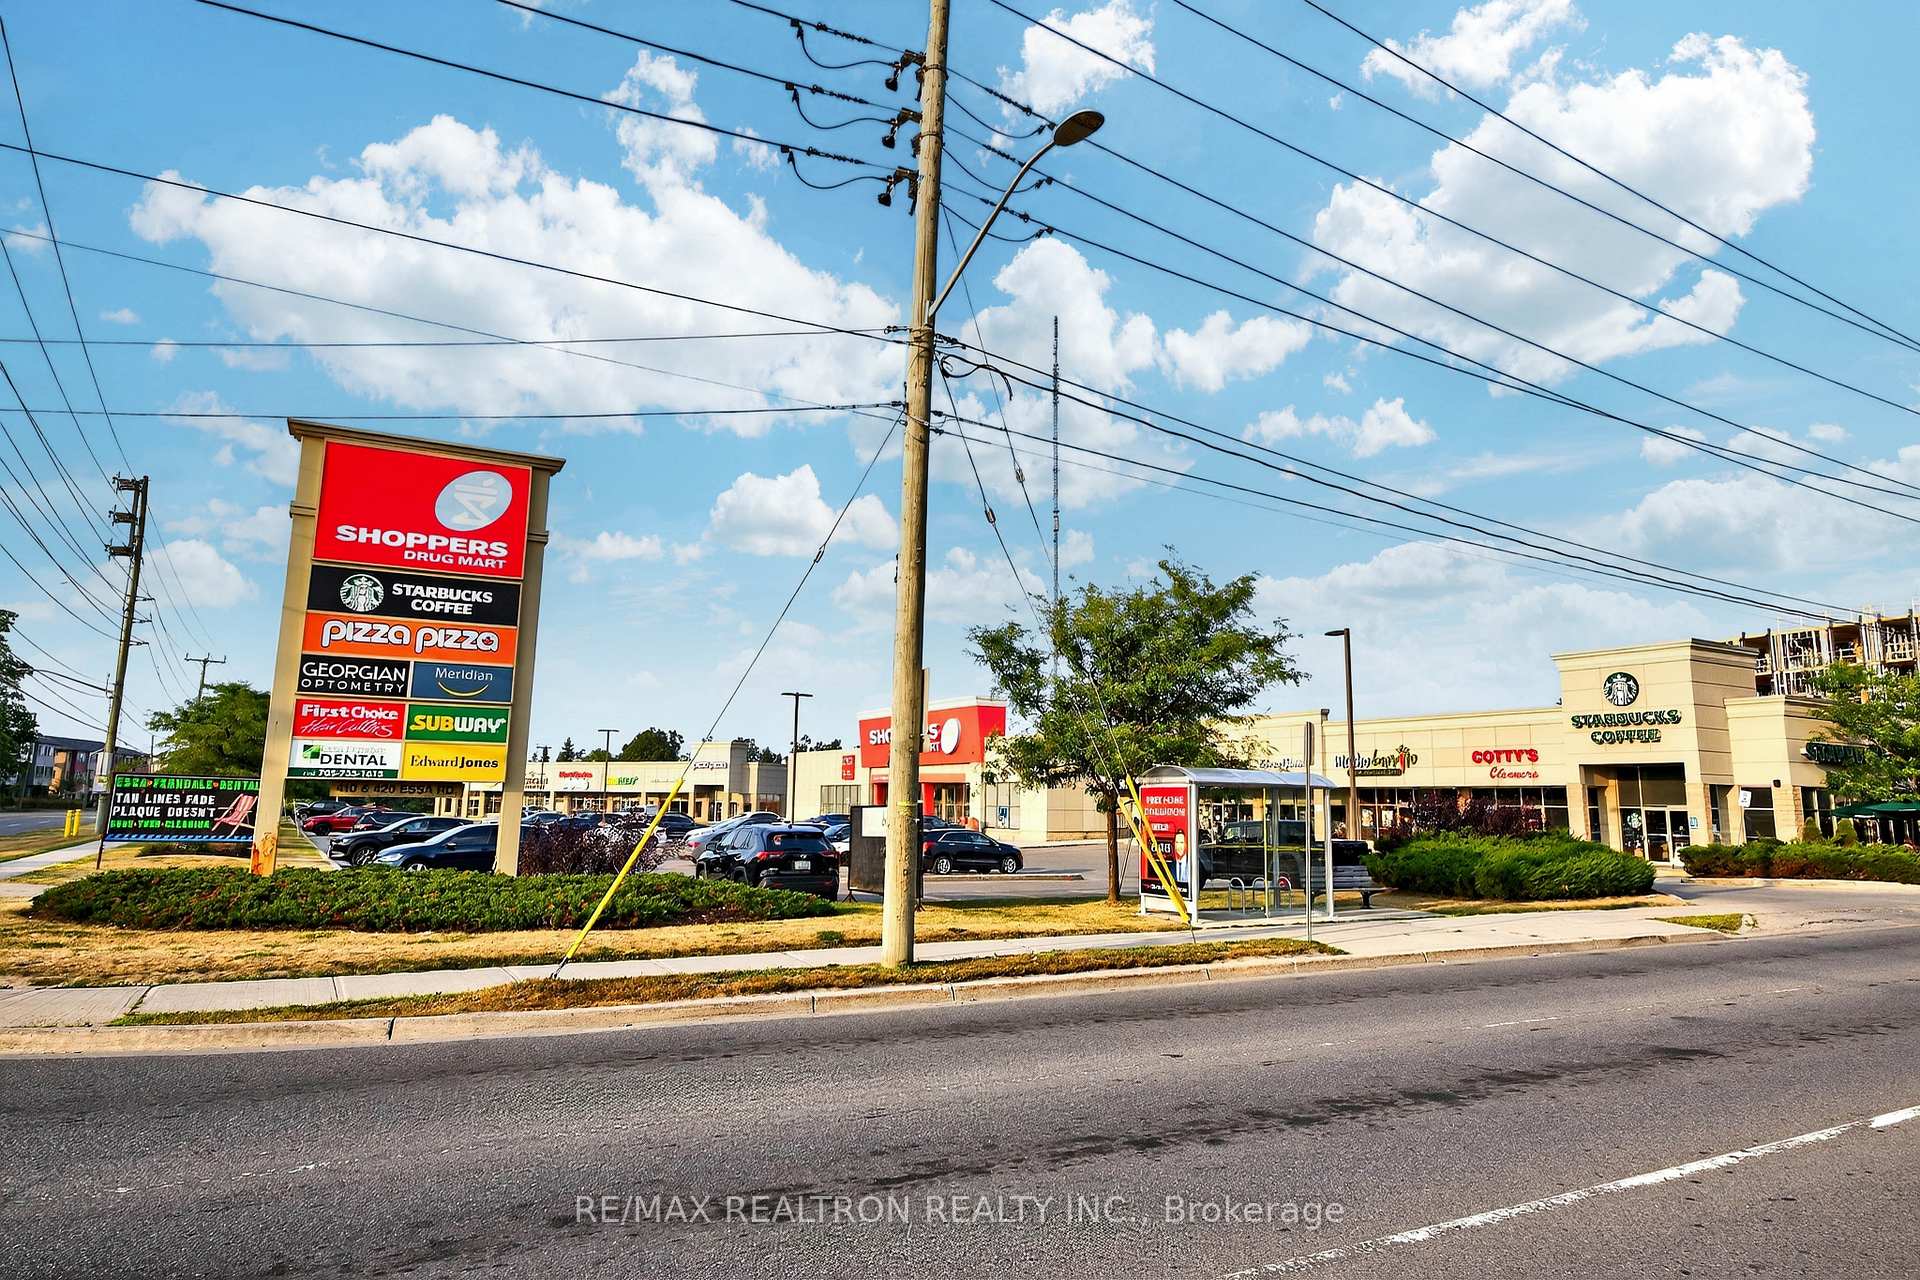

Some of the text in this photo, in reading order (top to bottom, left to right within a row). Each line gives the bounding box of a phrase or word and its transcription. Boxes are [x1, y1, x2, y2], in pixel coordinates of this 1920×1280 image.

[335, 525, 509, 557] SHOPPERS
[404, 550, 507, 569] DRUG MART
[392, 583, 493, 604] STARBUCKS
[411, 599, 473, 615] COFFEE
[321, 620, 499, 654] pizza pizza
[302, 662, 406, 682] GEORGIAN
[435, 667, 493, 681] Meridian
[301, 679, 405, 693] OPTOMETRY
[301, 704, 399, 720] First Choice
[1571, 709, 1682, 729] STARBUCKS
[410, 715, 507, 733] SUBWAY
[1591, 729, 1662, 745] COFFEE
[320, 754, 387, 766] DENTAL
[115, 793, 215, 805] TAN LINES FADE
[112, 806, 216, 818] PLAQUE DOESN'T
